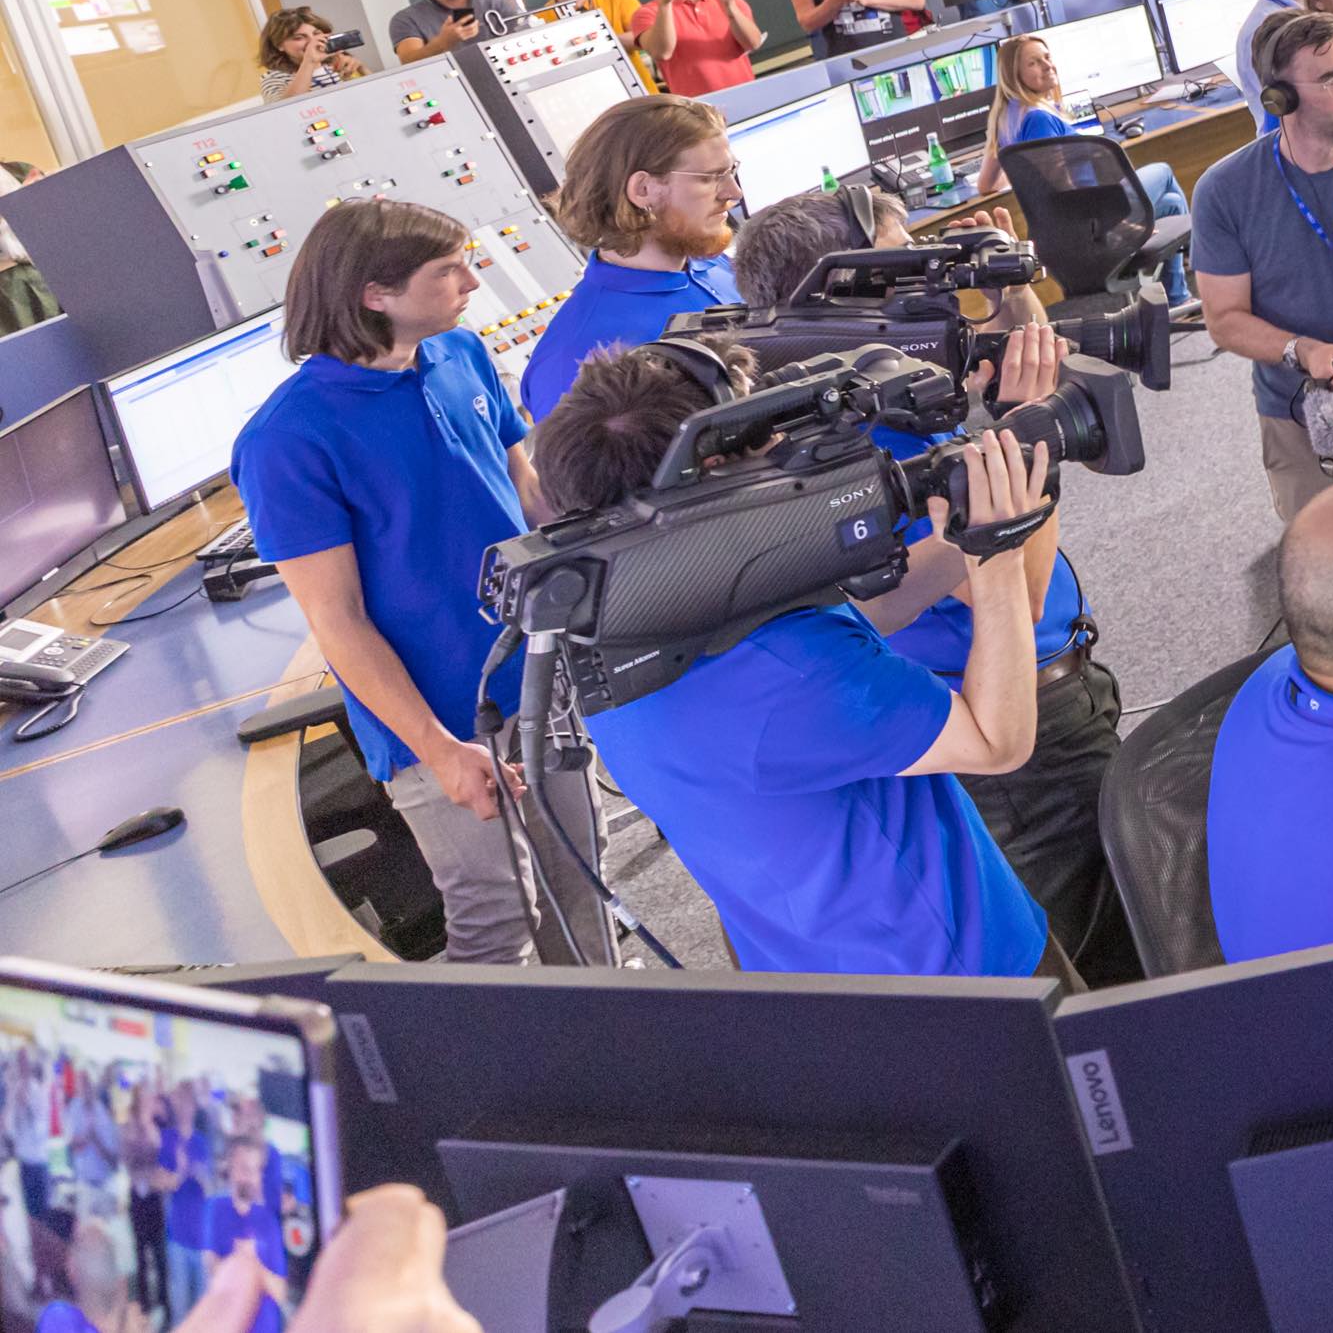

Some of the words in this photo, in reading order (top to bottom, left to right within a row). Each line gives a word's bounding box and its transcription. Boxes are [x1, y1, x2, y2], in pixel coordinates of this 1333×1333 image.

[901, 341, 939, 353] SONY
[829, 484, 875, 508] SONY
[853, 520, 868, 540] 6
[1083, 1062, 1121, 1145] Lenovo
